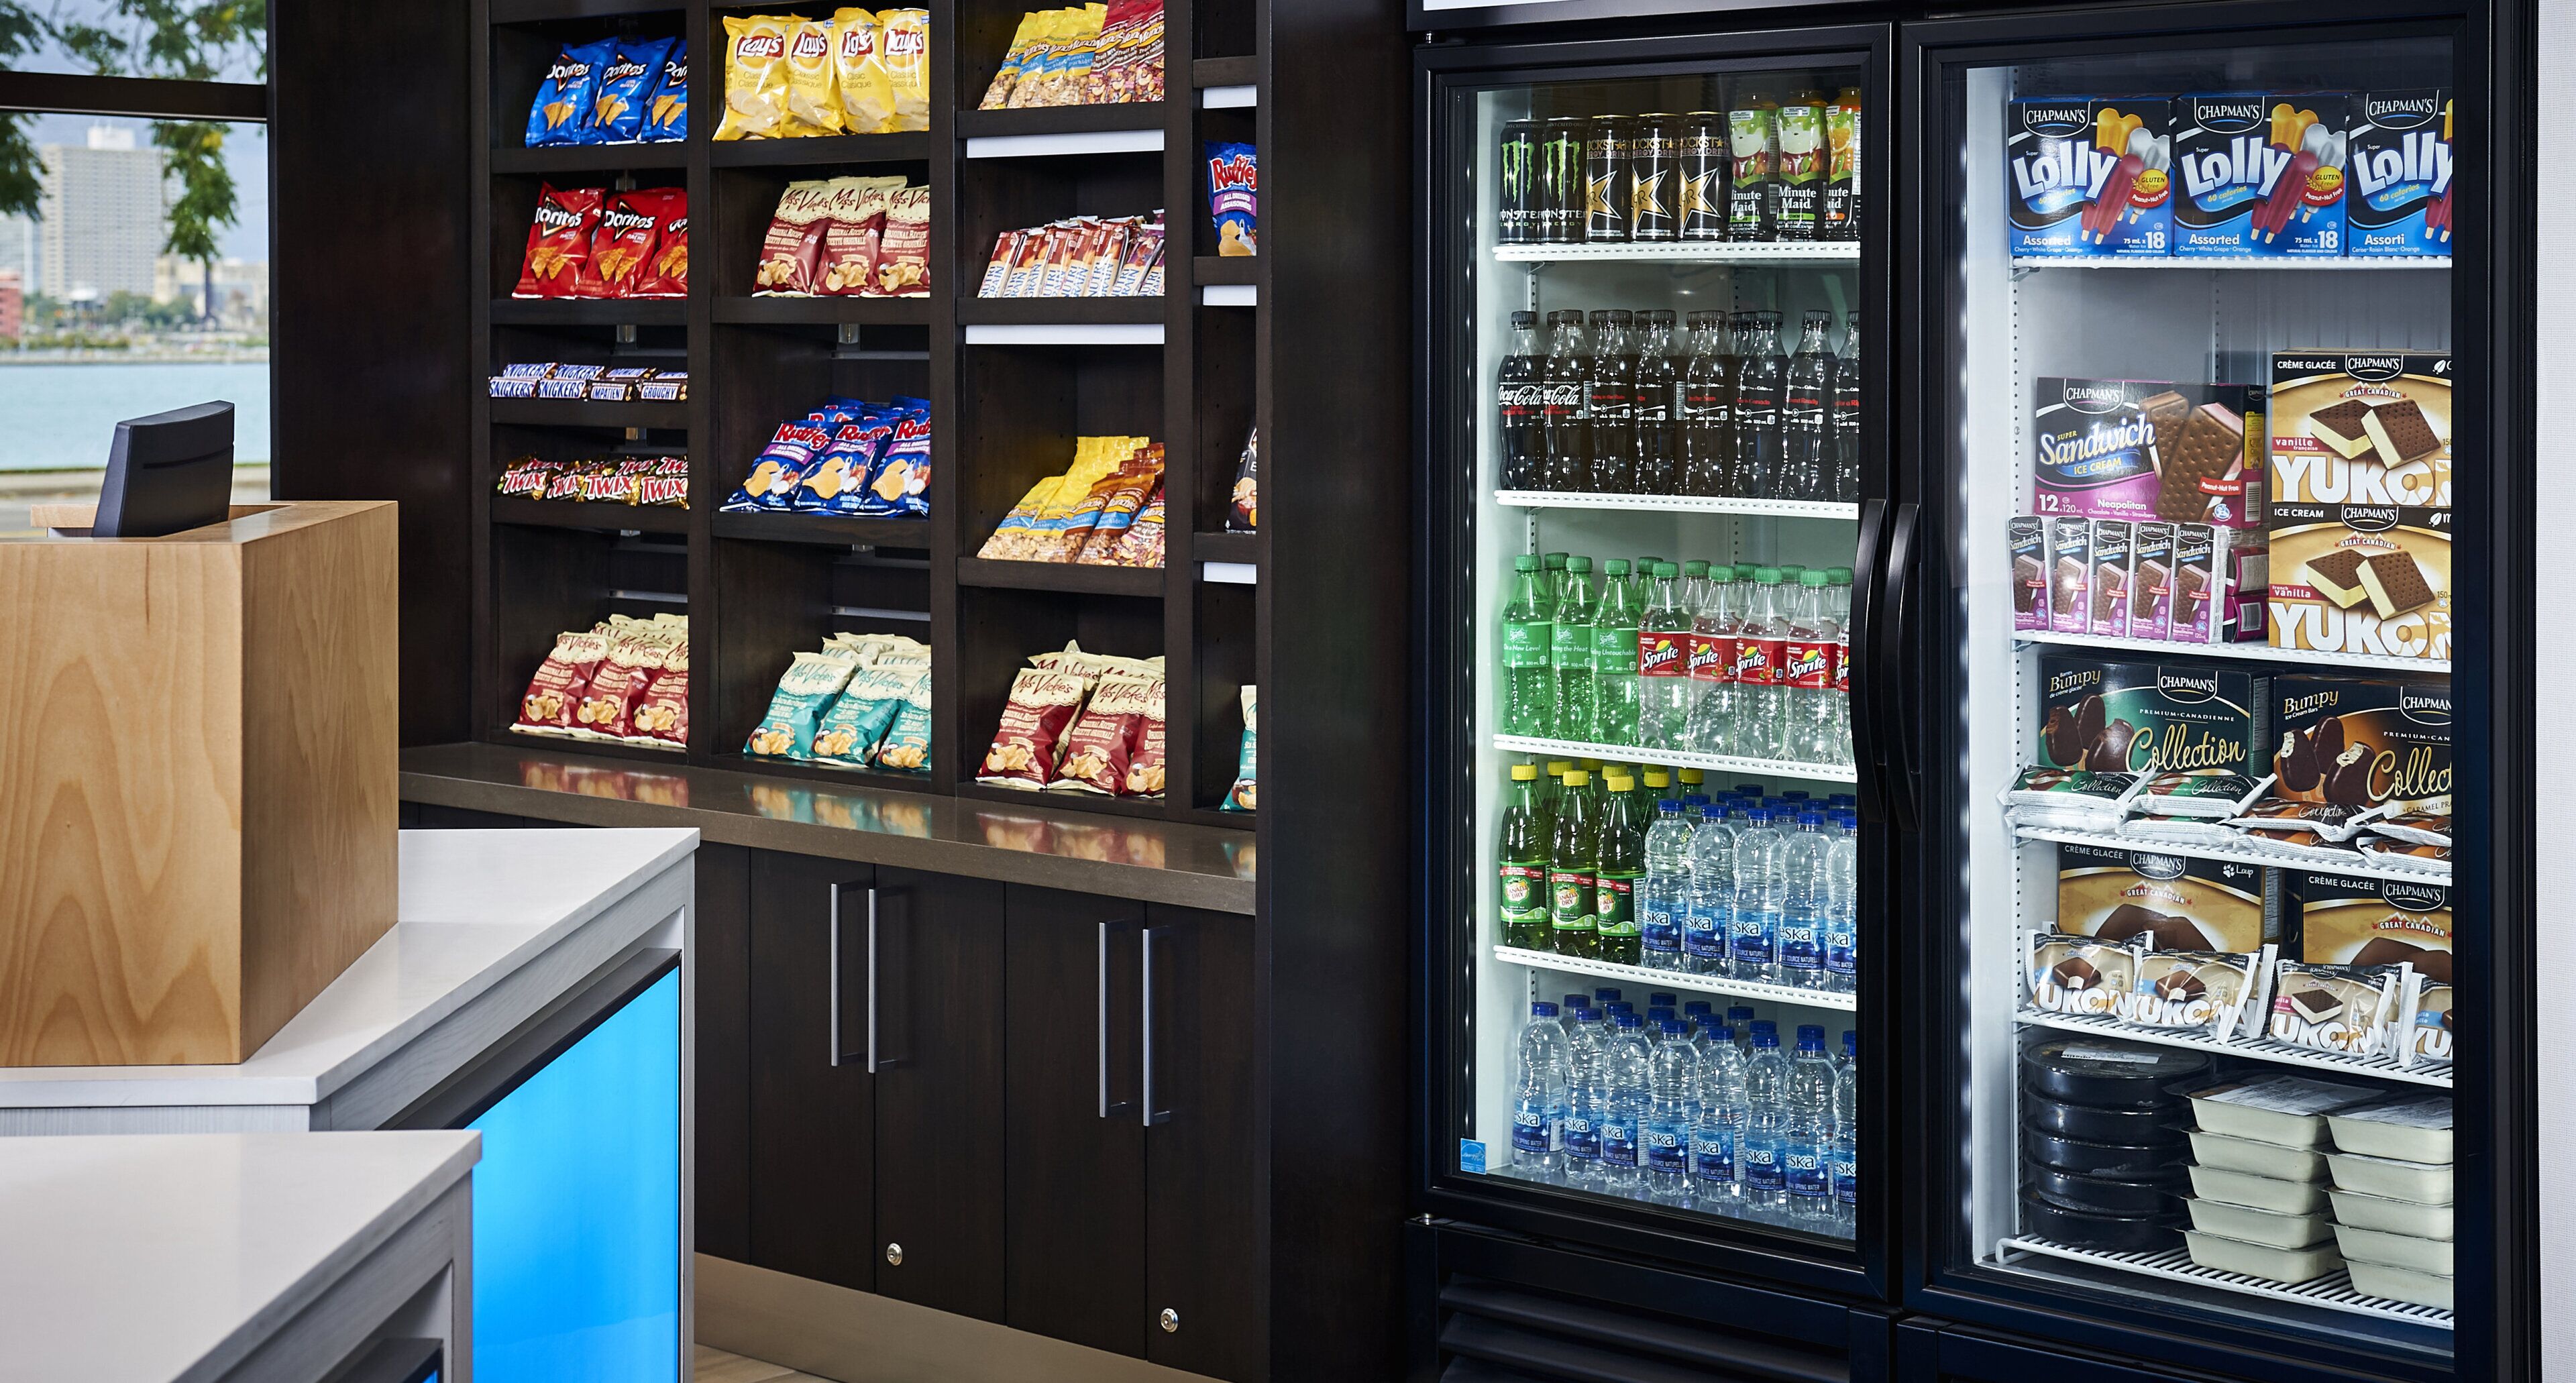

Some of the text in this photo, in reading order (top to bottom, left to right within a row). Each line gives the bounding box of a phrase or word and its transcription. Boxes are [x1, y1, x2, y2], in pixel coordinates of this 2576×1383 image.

[738, 36, 784, 57] Lay's
[792, 33, 827, 57] Lay's
[2198, 104, 2260, 120] CHAPMAN'S
[2369, 100, 2434, 116] CHAPMAN'S
[2027, 109, 2086, 125] CHAPMAN'S
[2013, 140, 2118, 199] Lolly
[2182, 137, 2292, 197] Lolly
[2354, 131, 2453, 196] Lolly
[1778, 186, 1817, 198] Minute
[2208, 186, 2247, 202] 60 calories
[2379, 184, 2420, 202] 60 calories
[1782, 198, 1811, 209] Maid
[604, 210, 655, 229] Doritos
[2023, 235, 2071, 246] Assorted
[2146, 231, 2165, 249] 18
[2189, 233, 2240, 245] Assorted
[2318, 231, 2338, 249] 18
[2365, 234, 2405, 245] Assorti
[2277, 359, 2336, 370] CRÈME GLACÉE
[2348, 357, 2400, 370] CHAPMAN'S
[489, 380, 535, 397] SNICKERS
[538, 380, 584, 398] SNICKERS
[1498, 385, 1544, 406] Coca-Cola
[2065, 387, 2120, 402] CHAPMAN'S
[2345, 388, 2401, 398] GREAT CANADIAN
[2040, 414, 2155, 465] Sandwich
[2057, 431, 2077, 441] SUPER
[2275, 438, 2313, 446] vanille
[2074, 459, 2121, 475] ICE CREAM
[2039, 494, 2058, 512] 12
[2097, 499, 2147, 510] Neapolitan
[2274, 508, 2324, 518] ICE CREAM
[2344, 507, 2396, 521] CHAPMAN'S
[2180, 529, 2208, 539] CHAPMAN'S
[2009, 534, 2041, 551] Sandwich
[2055, 537, 2087, 551] Sandwich
[2094, 543, 2128, 557] Sandwich
[2136, 539, 2171, 553] Sandwich
[2340, 538, 2395, 549] GREAT CANADIAN
[2176, 543, 2211, 559] Sandwich
[2274, 588, 2311, 599] vanilla
[1644, 647, 1678, 669] Sprite
[1688, 651, 1718, 669] Sprite
[1790, 657, 1826, 679] Sprite
[2049, 669, 2102, 692] Bumpy
[2160, 675, 2215, 692] CHAPMAN'S
[2283, 690, 2339, 714] Bumpy
[2292, 709, 2308, 719] Cream
[2308, 707, 2318, 715] Bars
[2125, 723, 2246, 772] Collection
[2191, 779, 2244, 796] Collection
[2065, 844, 2123, 860] CRÈME GLACÉE
[2133, 853, 2182, 870] CHAPMAN'S
[2236, 865, 2253, 878] Loup
[2308, 876, 2375, 891] CRÈME GLACÉE
[2127, 889, 2186, 905] GREAT CANADIAN
[2385, 884, 2441, 901] CHAPMAN'S
[1731, 921, 1759, 935] eska
[1779, 927, 1811, 941] eska
[2379, 921, 2445, 937] GREAT CANADIAN
[1786, 1154, 1815, 1168] eska
